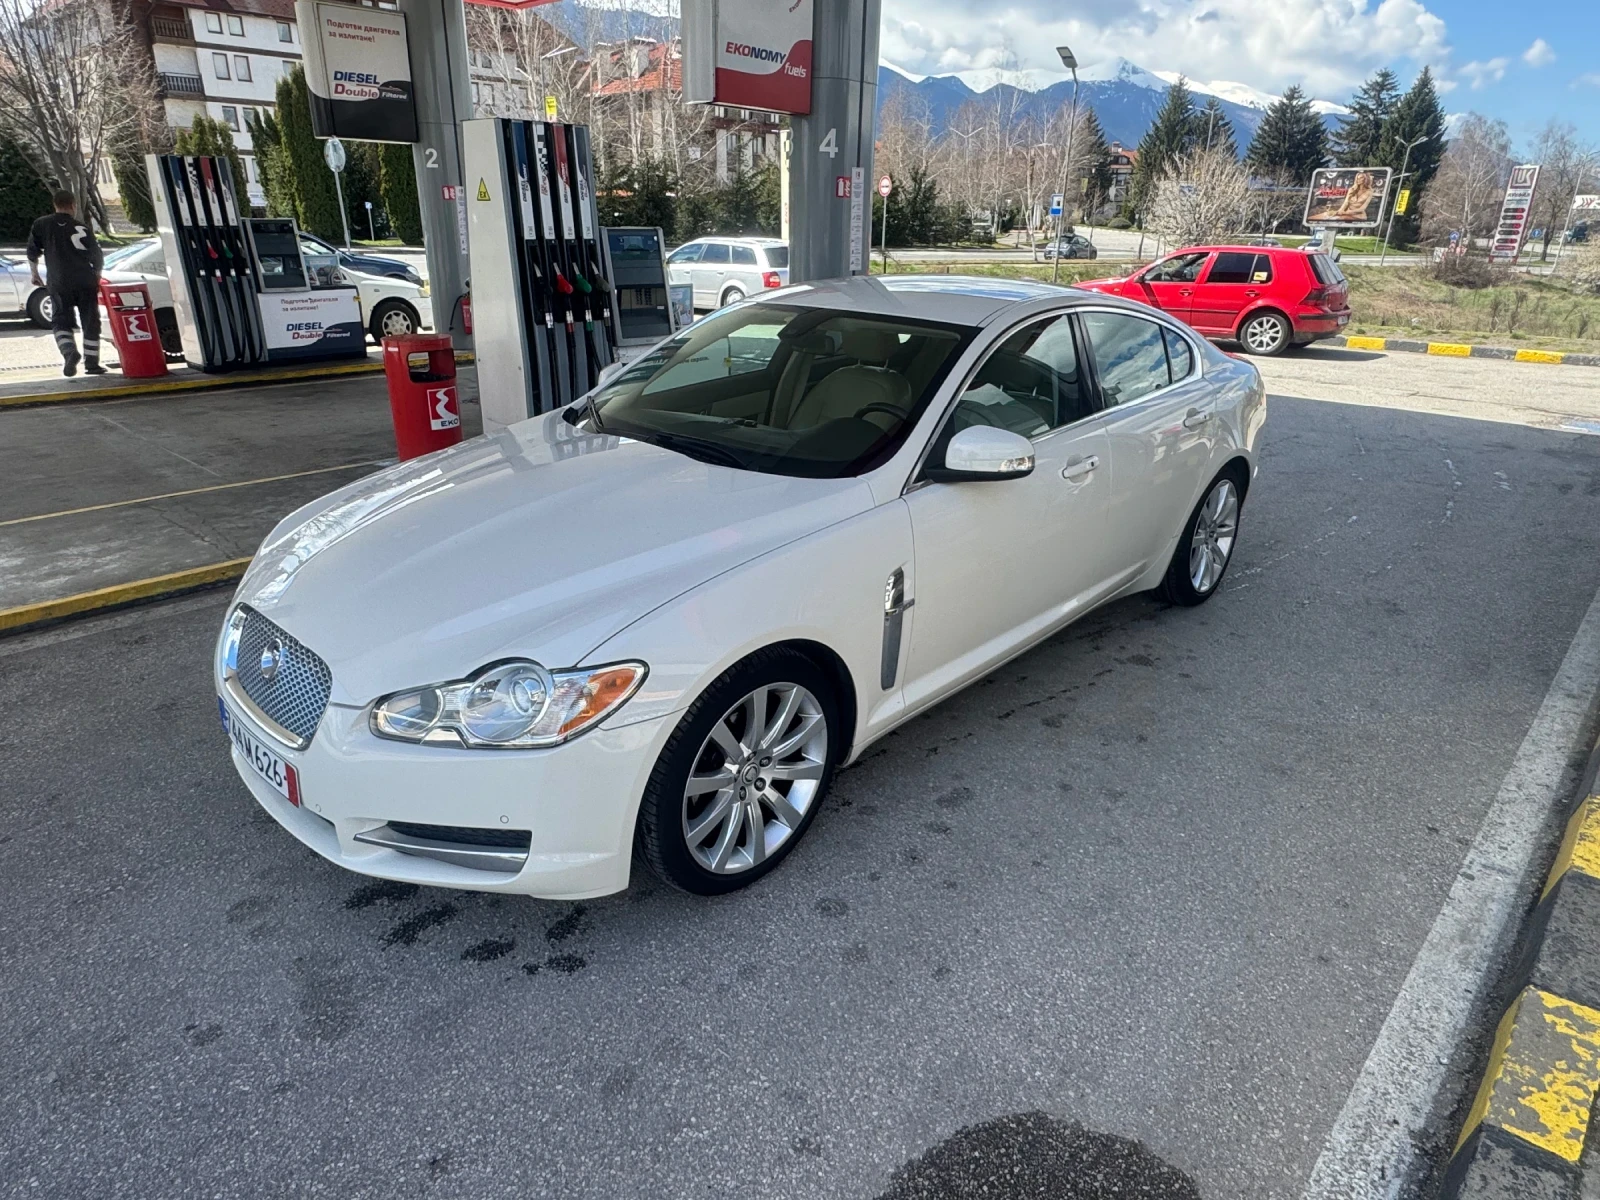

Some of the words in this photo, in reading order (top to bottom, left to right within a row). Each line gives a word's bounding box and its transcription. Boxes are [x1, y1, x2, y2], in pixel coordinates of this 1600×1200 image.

[327, 19, 362, 31] Подготви
[364, 25, 400, 36] двигателя
[338, 32, 375, 43] излитане!
[725, 41, 786, 64] EKONOMY
[784, 62, 806, 77] fuels
[333, 70, 380, 85] DIESEL
[334, 83, 378, 99] Double
[382, 91, 407, 99] Filtered
[819, 128, 838, 158] 4
[425, 148, 439, 168] 2
[286, 321, 324, 331] DIESEL
[292, 331, 323, 340] Double
[440, 418, 459, 427] EKO
